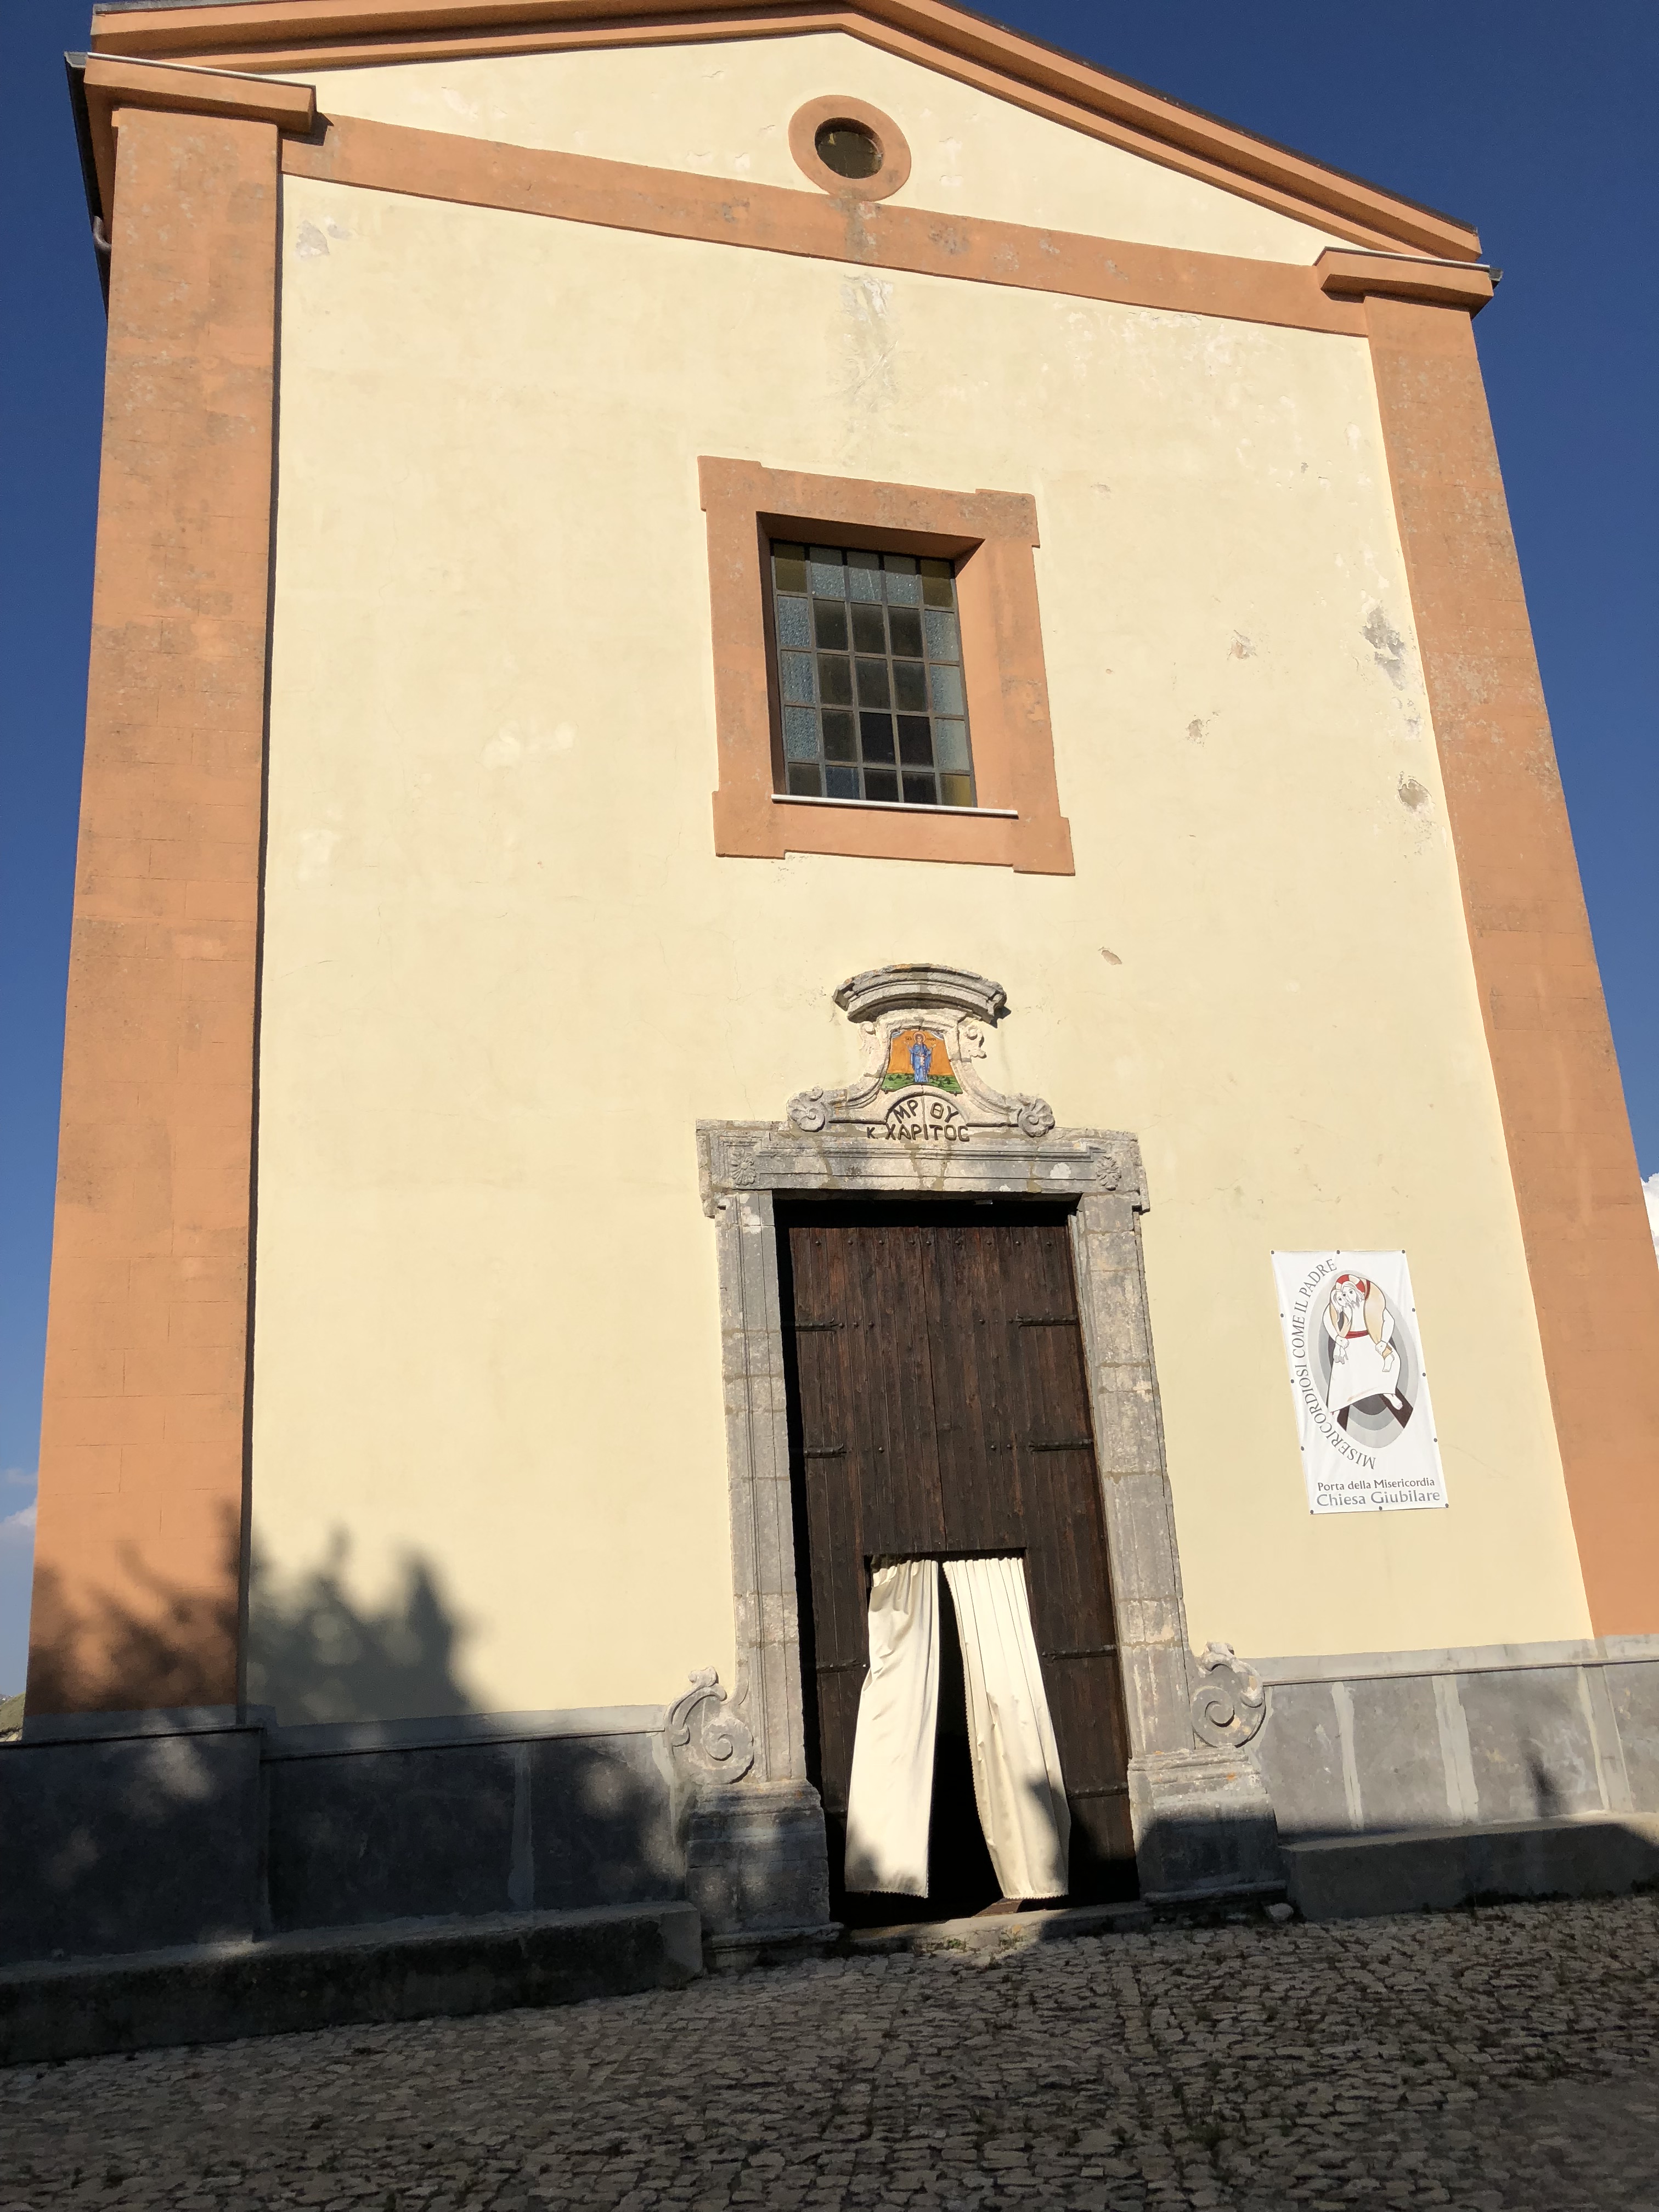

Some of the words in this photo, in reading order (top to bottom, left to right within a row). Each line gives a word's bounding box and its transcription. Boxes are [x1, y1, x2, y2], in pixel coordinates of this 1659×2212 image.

[1299, 1259, 1337, 1298] PADRE
[1294, 1300, 1308, 1314] IL
[1291, 1314, 1306, 1358] COME
[1295, 1364, 1376, 1470] MISERICORDIOSI
[1317, 1482, 1345, 1491] Porta
[1347, 1481, 1371, 1490] della
[1373, 1477, 1435, 1488] Misericordia
[1317, 1493, 1366, 1506] Chiesa
[1370, 1489, 1440, 1504] Giubilare
